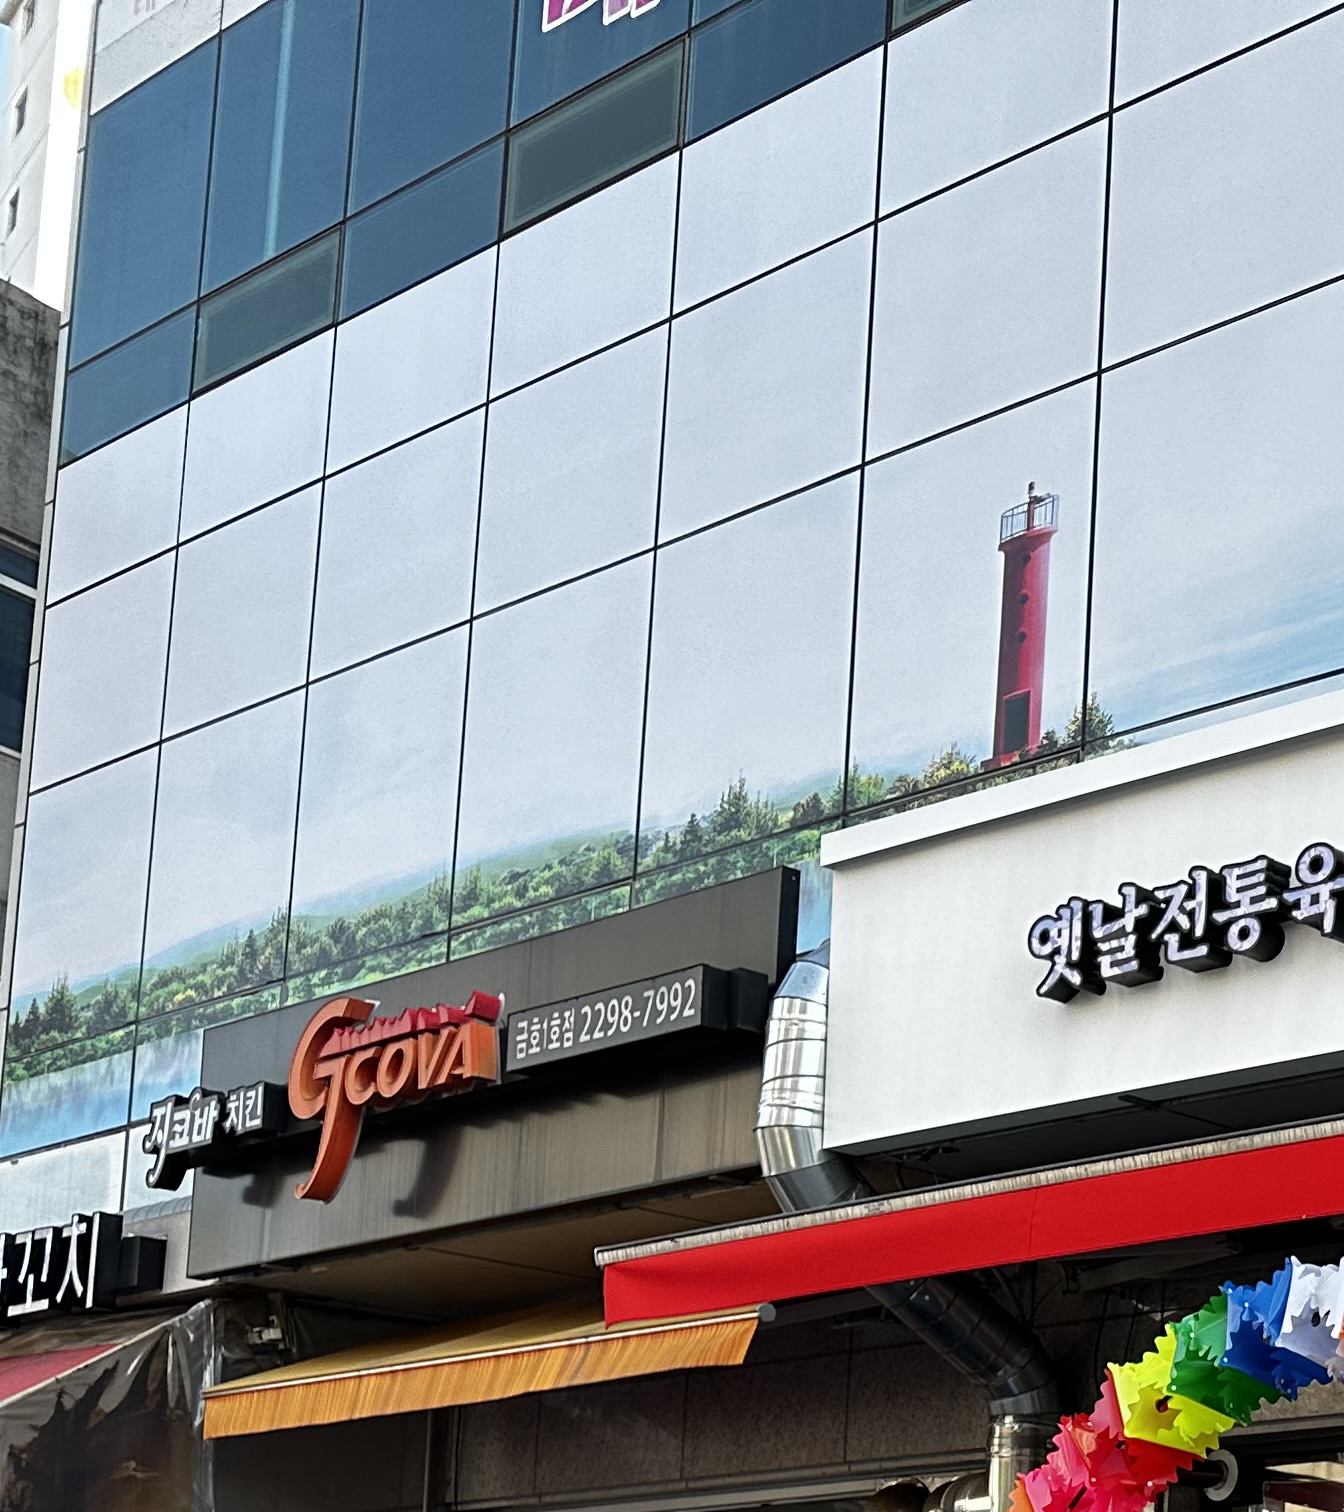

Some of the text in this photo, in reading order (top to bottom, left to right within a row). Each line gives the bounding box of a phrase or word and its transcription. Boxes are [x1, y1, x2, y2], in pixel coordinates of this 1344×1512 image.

[515, 978, 698, 1060] 금호1호점 2298-7992
[144, 1083, 265, 1190] 지코바 치킨
[0, 1211, 100, 1317] 꼬치
